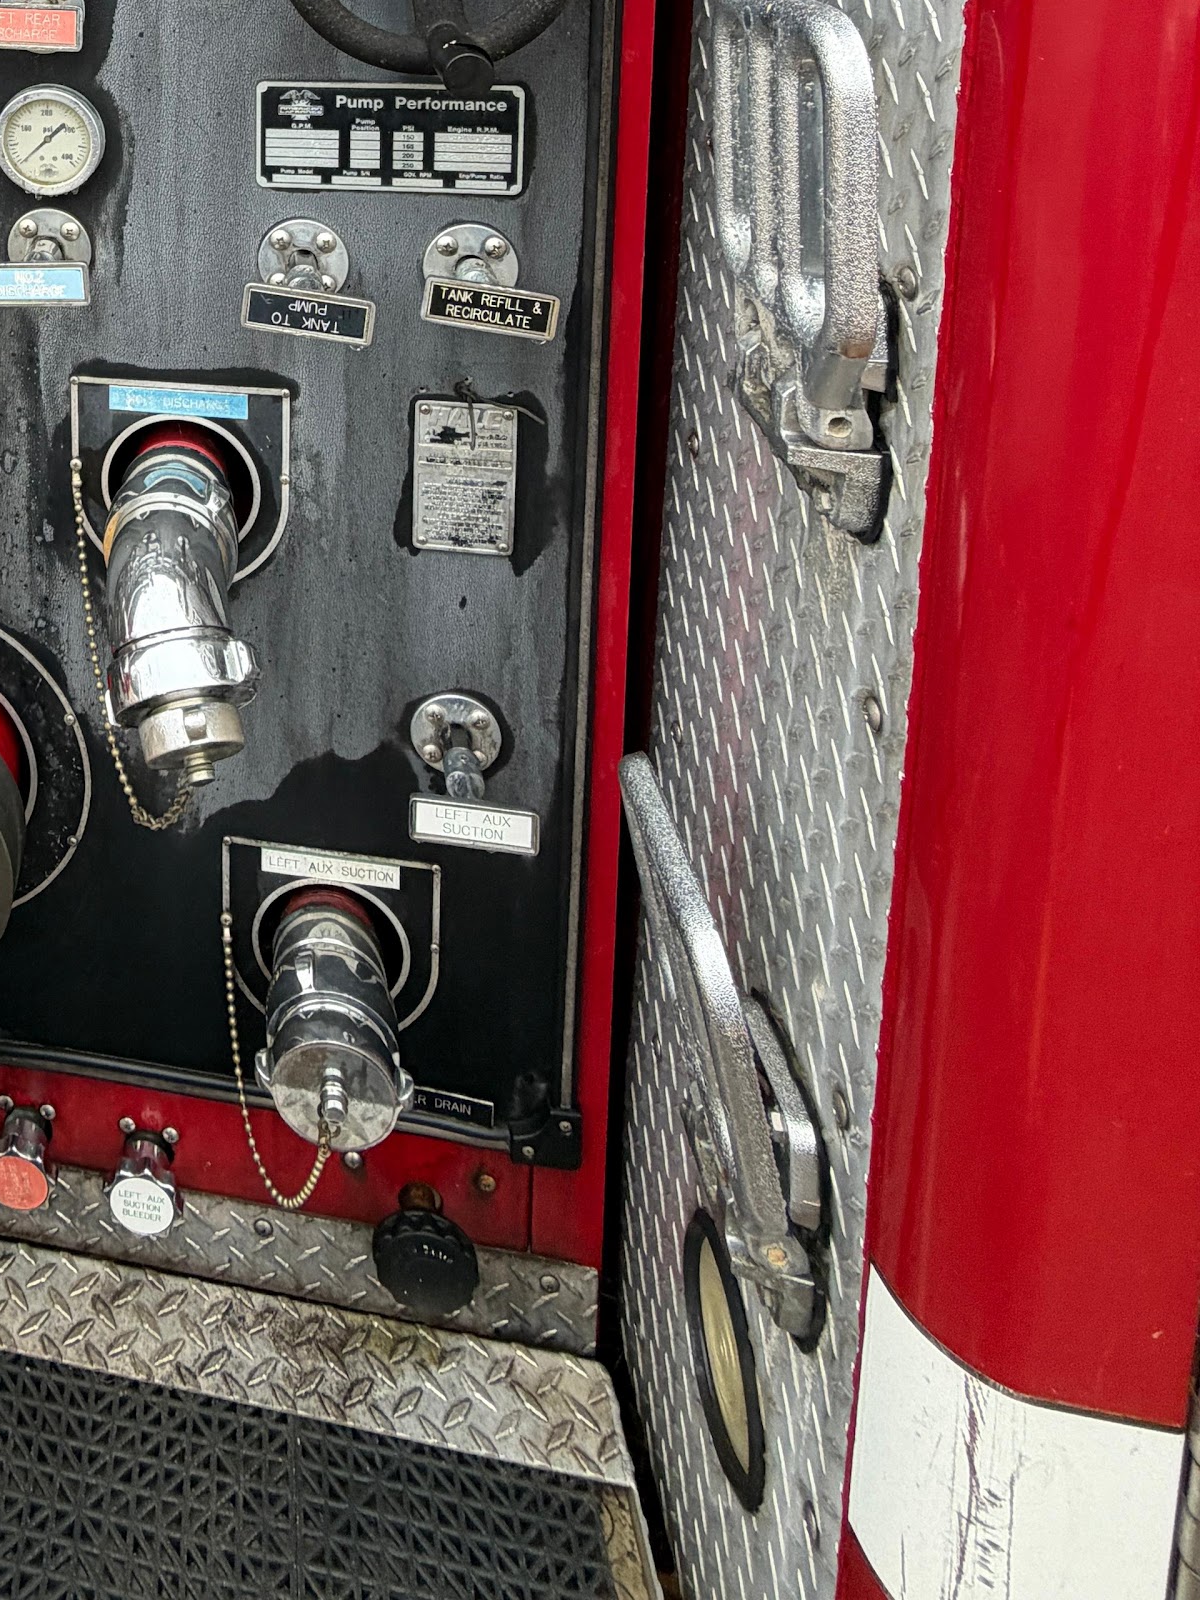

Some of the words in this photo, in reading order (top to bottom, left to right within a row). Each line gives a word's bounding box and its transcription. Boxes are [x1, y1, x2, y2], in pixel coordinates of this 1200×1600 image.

[24, 13, 61, 26] REAR
[335, 94, 384, 113] Pump
[395, 95, 508, 113] Performance
[355, 117, 376, 126] Pump
[447, 126, 473, 134] Engine
[13, 271, 45, 284] NO.2
[439, 286, 473, 303] TANK
[481, 293, 524, 312] REFILL
[532, 302, 543, 315] &
[288, 302, 328, 316] PUMP
[444, 303, 532, 329] RECIRCULATE
[271, 311, 291, 326] TO
[301, 320, 340, 334] TANK
[435, 807, 471, 823] LEFT
[482, 813, 512, 829] AUX
[442, 822, 504, 842] SUCTION
[268, 855, 299, 872] LEFT
[308, 860, 334, 876] AUX
[341, 865, 395, 884] SUCTION
[434, 1097, 472, 1116] DRAIN
[118, 1189, 141, 1200] LEFT
[147, 1194, 165, 1205] AUX
[123, 1199, 161, 1213] SUCTION
[122, 1208, 162, 1222] BLEEDER
